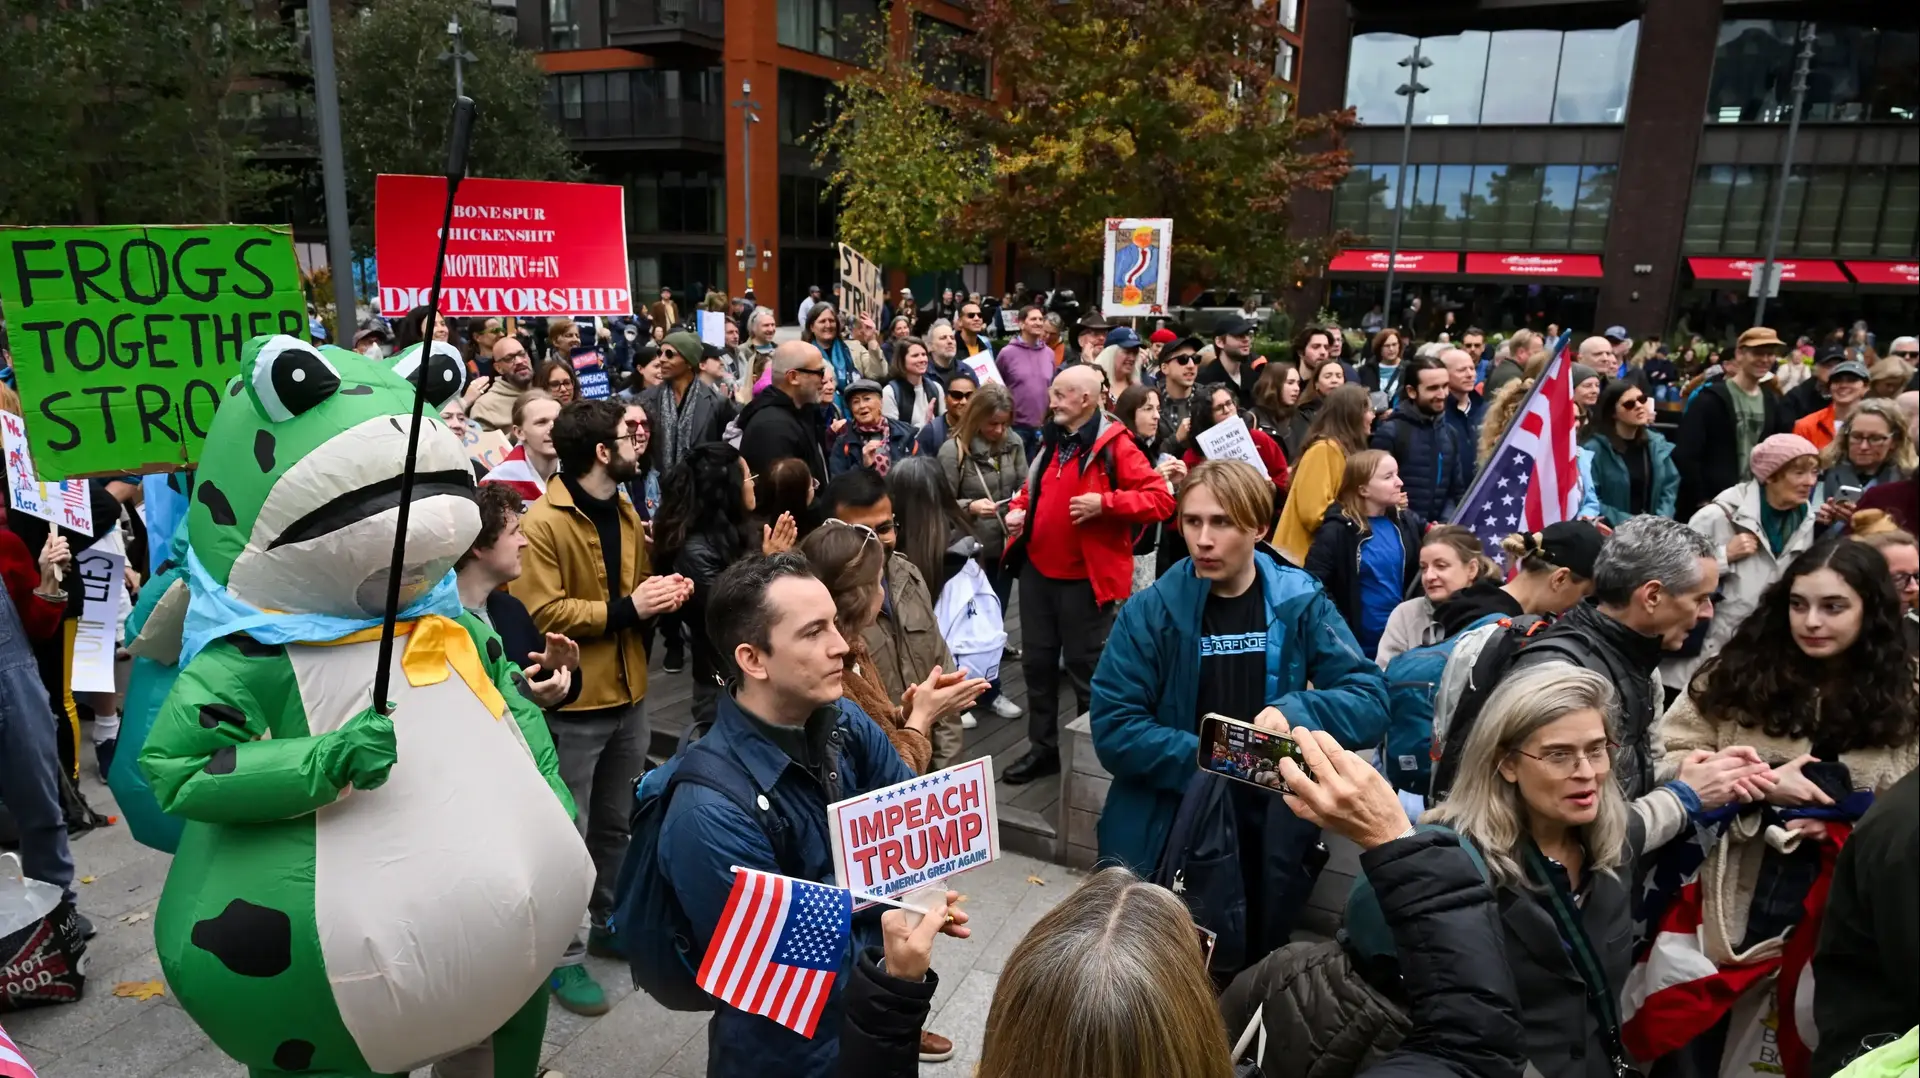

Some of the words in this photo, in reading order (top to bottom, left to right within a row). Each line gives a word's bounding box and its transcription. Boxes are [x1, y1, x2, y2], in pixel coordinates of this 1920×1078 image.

[453, 205, 500, 219] BONE
[504, 207, 546, 221] SPUR
[12, 237, 275, 308] FROGS
[443, 254, 559, 279] MOTHERFU##IN
[380, 287, 628, 313] DICTATORSHIP
[21, 310, 304, 373] TOGETHER
[3, 415, 22, 437] We
[39, 379, 224, 451] STRO
[1210, 435, 1226, 447] THIS
[1225, 428, 1241, 439] NEW
[14, 488, 38, 512] Here
[63, 508, 90, 530] There
[1202, 638, 1267, 652] STARFINDE
[849, 779, 980, 848] IMPEACH
[853, 812, 982, 886] TRUMP
[884, 870, 926, 895] AMERICA
[926, 860, 957, 879] GREAT
[957, 849, 988, 869] AGAIN!
[5, 952, 44, 979] NOT
